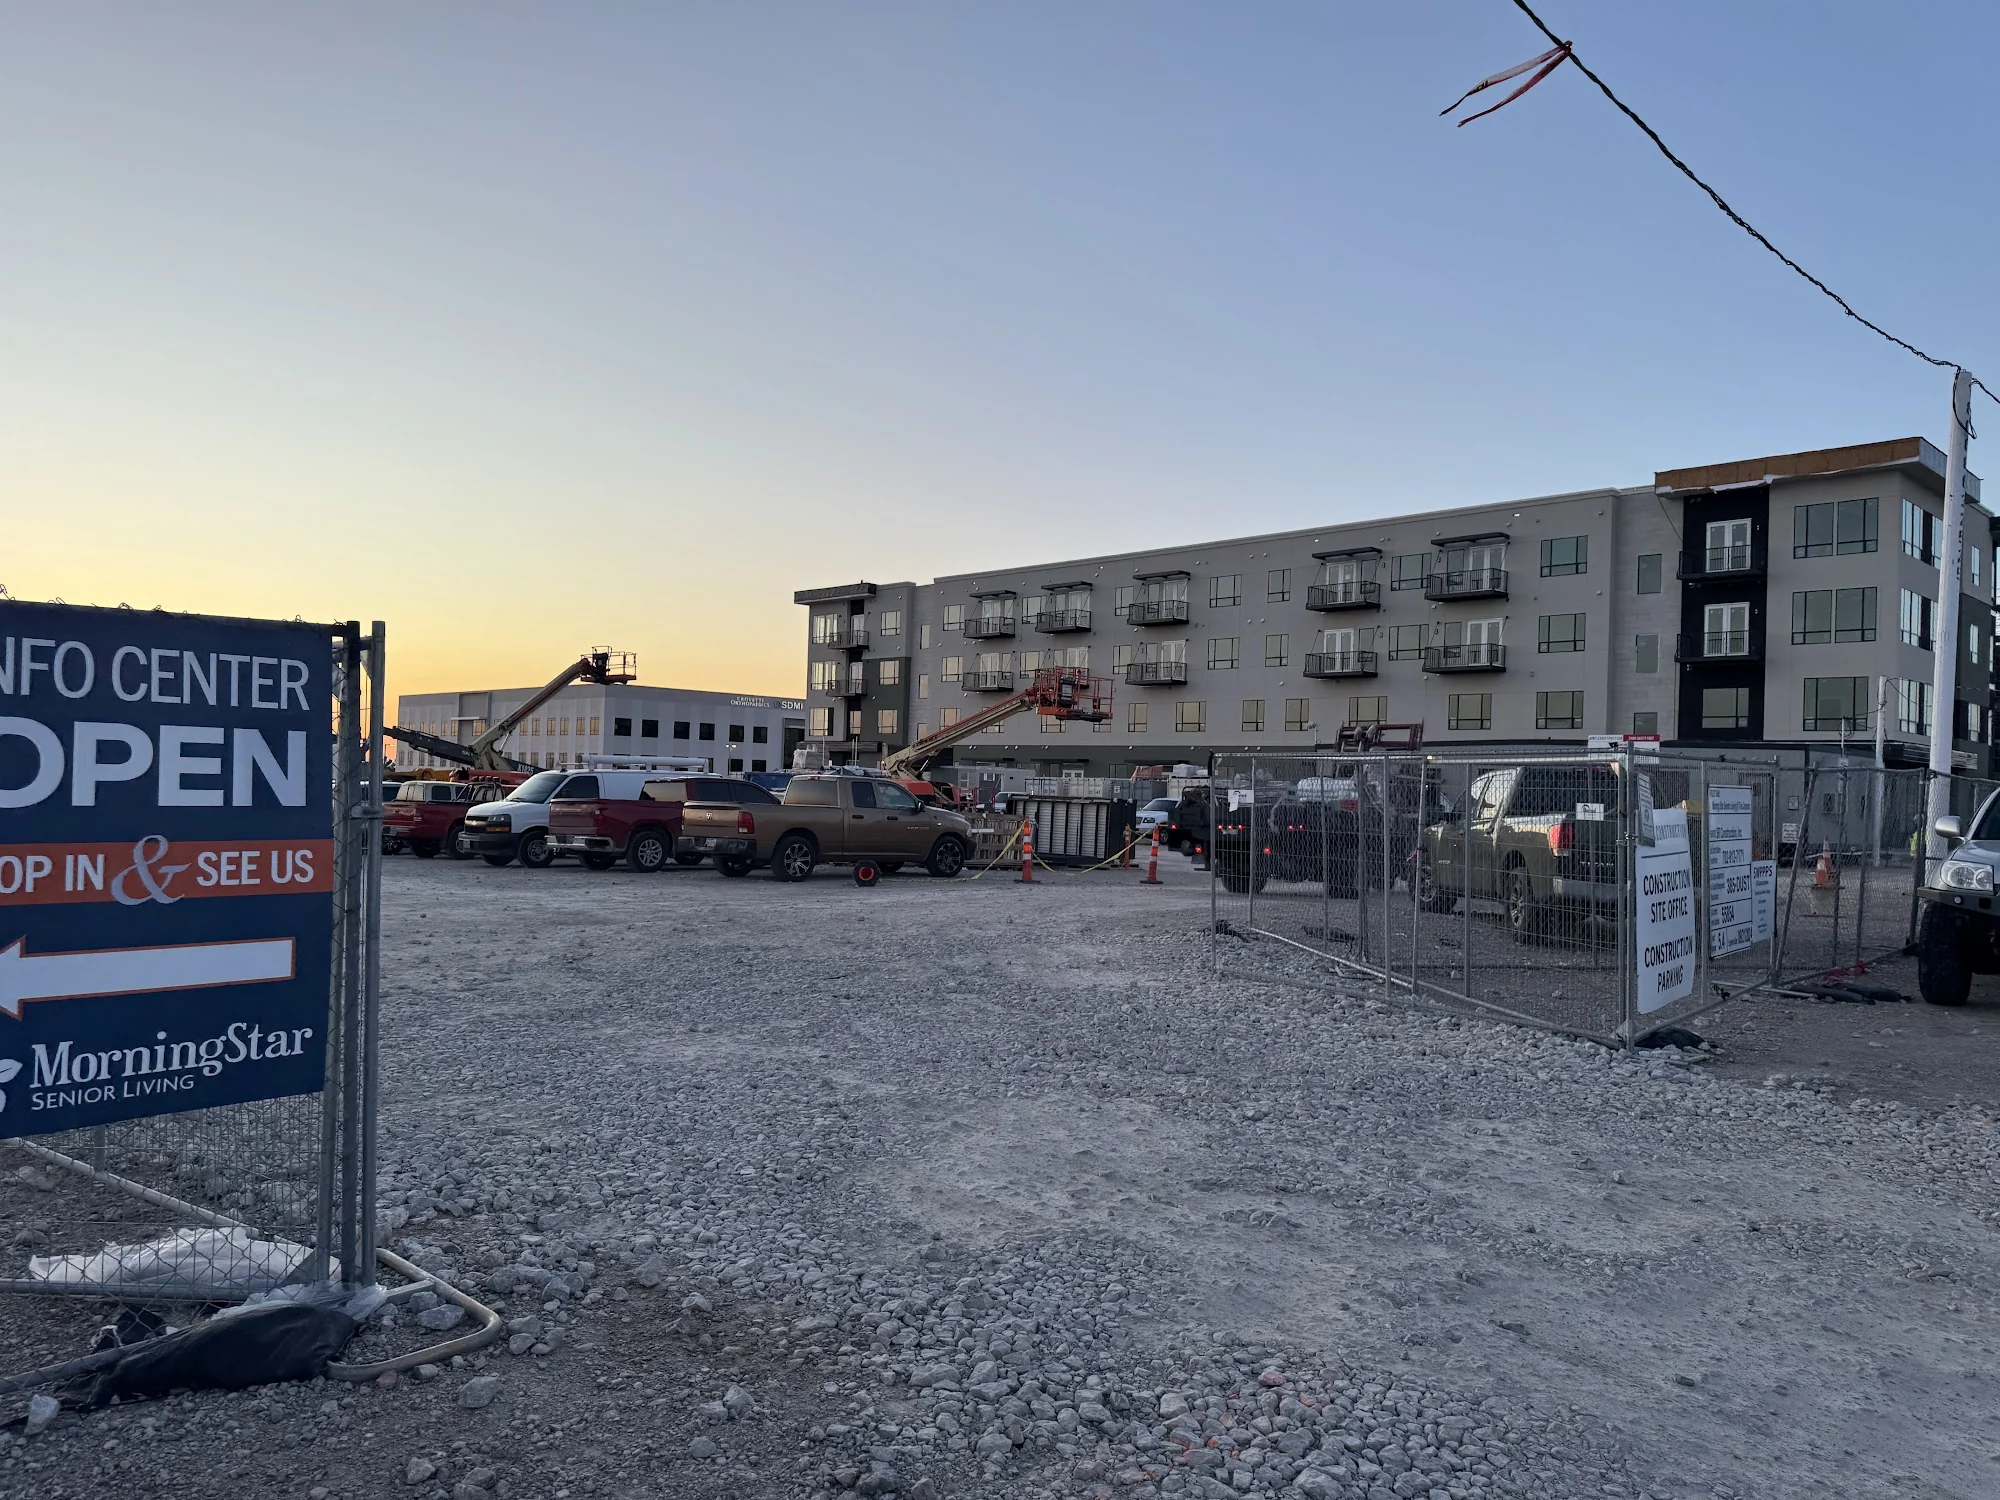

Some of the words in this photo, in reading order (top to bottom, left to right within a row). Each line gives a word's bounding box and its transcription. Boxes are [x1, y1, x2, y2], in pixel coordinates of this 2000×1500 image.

[112, 645, 310, 711] CENTER
[781, 701, 803, 710] SDMI
[0, 716, 307, 808] OPEN
[1656, 823, 1686, 842] CONSTRUCTION
[64, 854, 105, 892] IN
[111, 834, 192, 906] &
[197, 850, 260, 887] SEE
[270, 849, 314, 884] US
[1643, 866, 1690, 896] CONSTRUCTION
[1651, 900, 1666, 923] SITE
[1668, 896, 1688, 919] OFFICE
[1645, 936, 1693, 968] CONSTRUCTION
[1658, 965, 1683, 993] PARKING
[30, 1022, 313, 1089] MorningStar
[31, 1085, 116, 1111] SENIOR
[124, 1074, 195, 1099] LIVING
